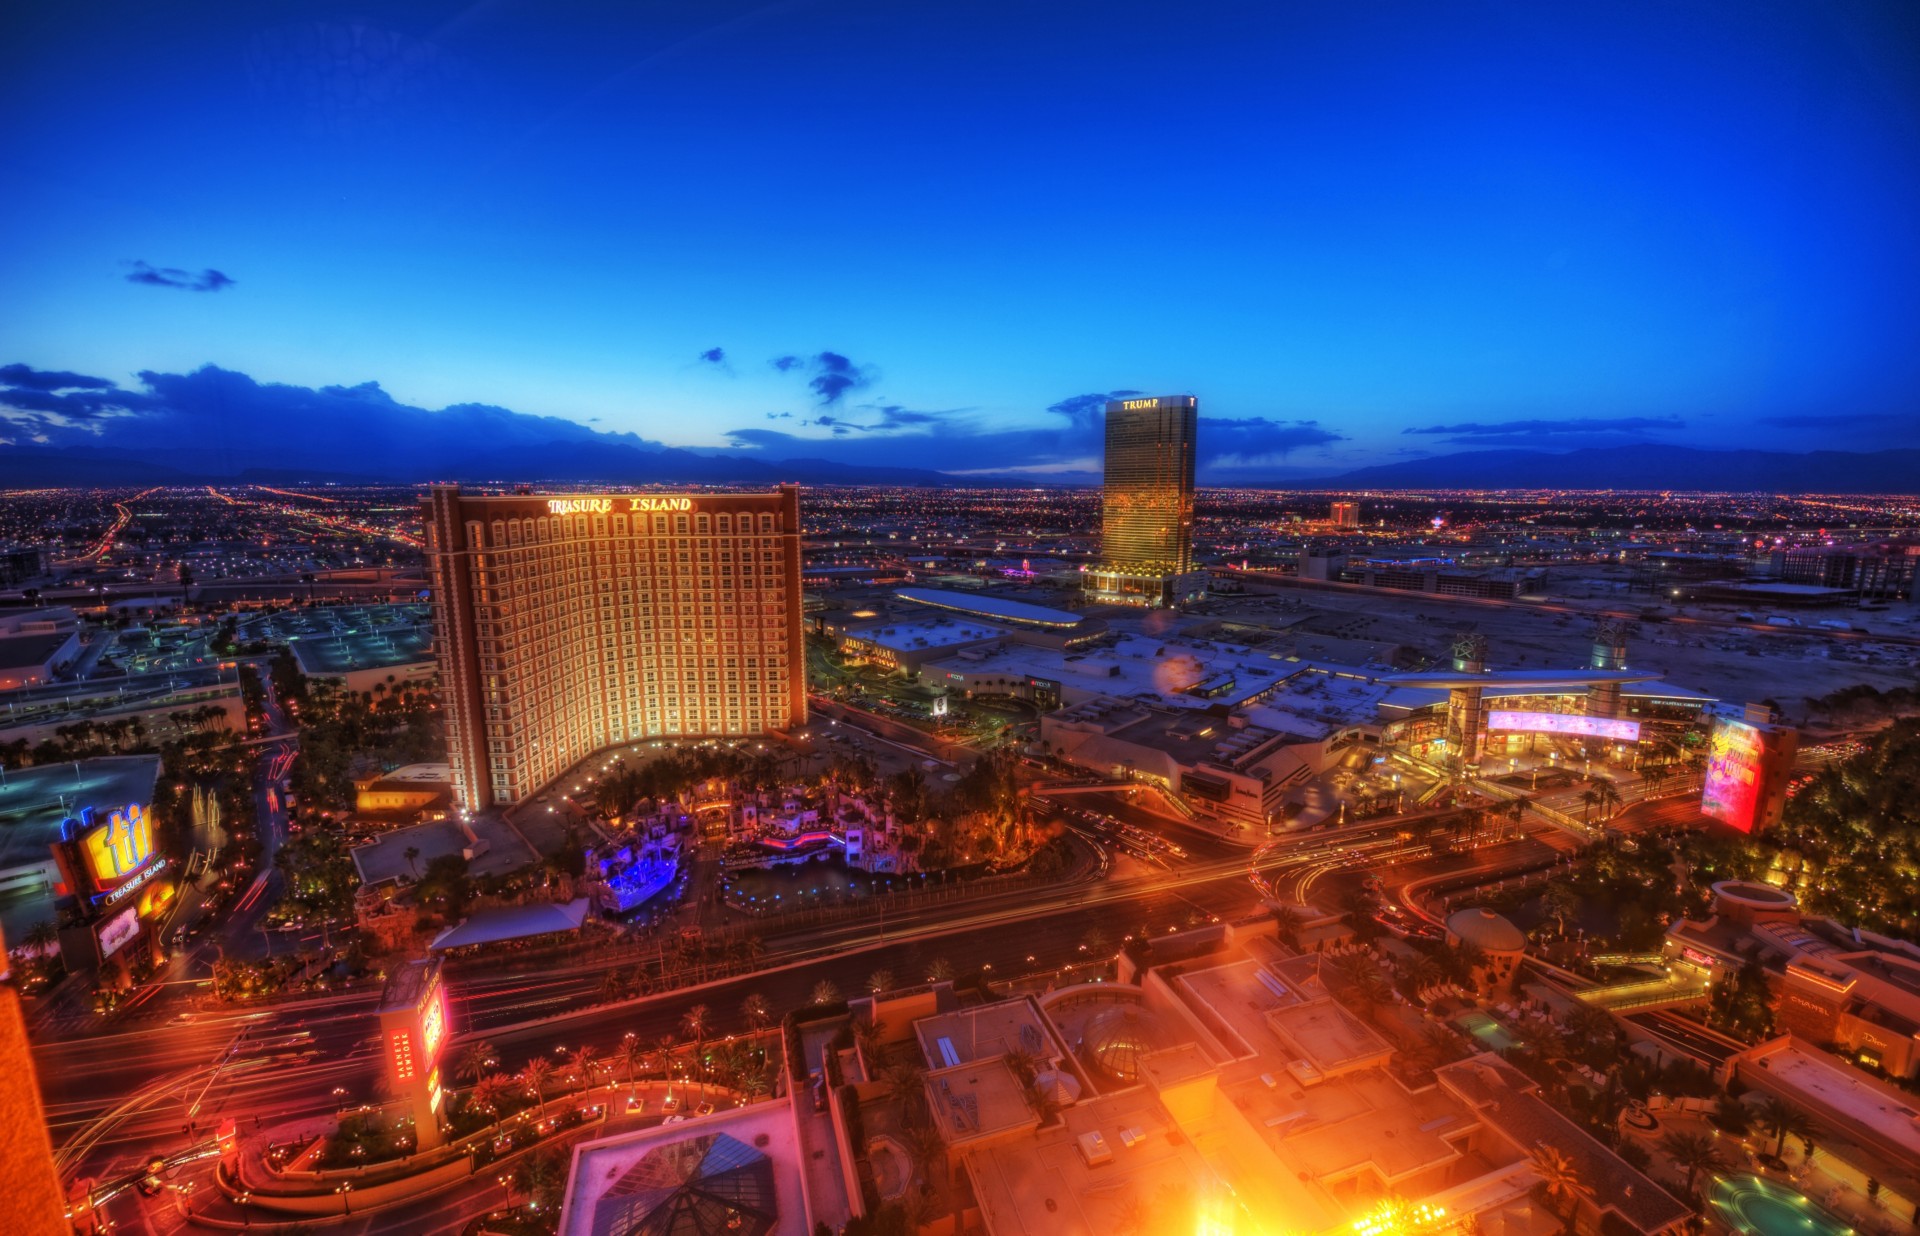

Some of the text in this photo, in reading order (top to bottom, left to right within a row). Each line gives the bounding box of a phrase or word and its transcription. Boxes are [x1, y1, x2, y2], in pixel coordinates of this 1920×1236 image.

[1123, 399, 1158, 410] TRUMP
[548, 498, 691, 515] TREASURE ISLAND
[110, 859, 166, 902] TREASURE ISLAND
[1790, 996, 1830, 1017] CHANEL
[1863, 1032, 1887, 1048] Dior
[393, 1035, 405, 1078] BARNEYS
